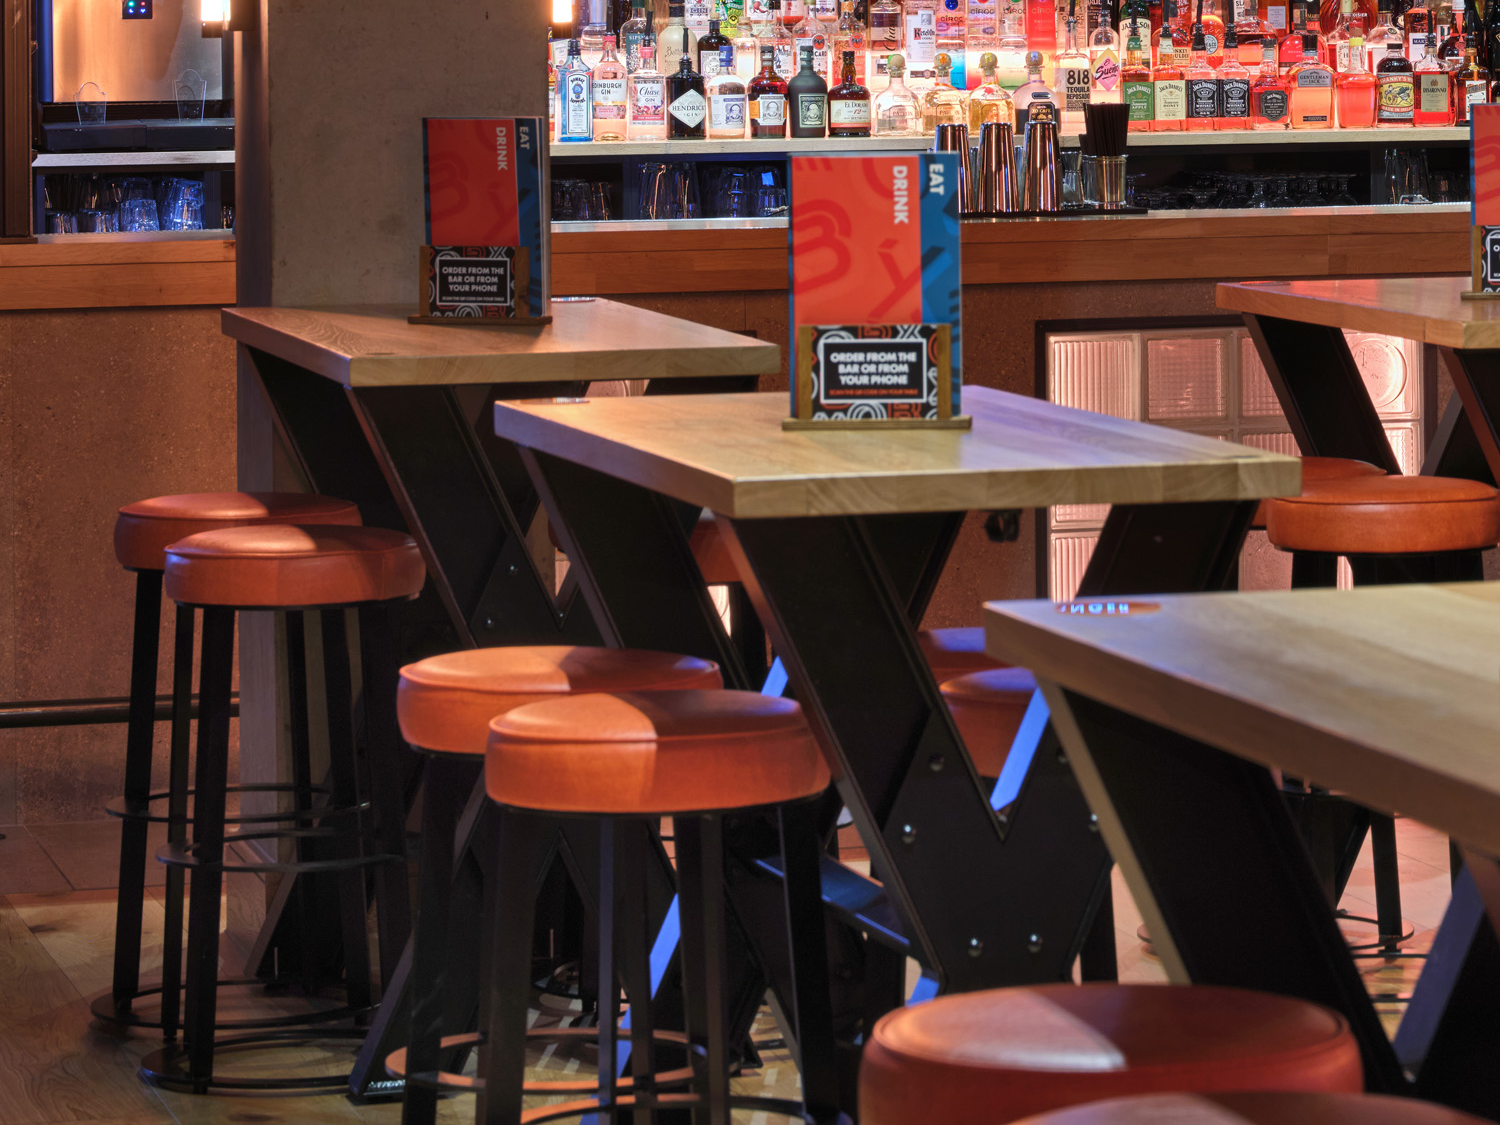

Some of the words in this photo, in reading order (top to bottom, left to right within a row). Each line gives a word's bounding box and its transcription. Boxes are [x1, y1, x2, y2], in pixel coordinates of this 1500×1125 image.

[1067, 70, 1089, 85] 818
[639, 87, 660, 95] Chase
[520, 127, 530, 149] EAT
[496, 127, 508, 171] DRINK
[929, 163, 944, 195] EAT
[893, 165, 908, 225] DRINK
[830, 352, 865, 363] ORDER
[866, 352, 897, 362] FROM
[898, 352, 917, 362] THE
[838, 364, 860, 373] BAR
[860, 364, 877, 373] OR
[878, 364, 909, 373] FROM
[839, 375, 869, 385] YOUR
[870, 375, 908, 385] PHONE
